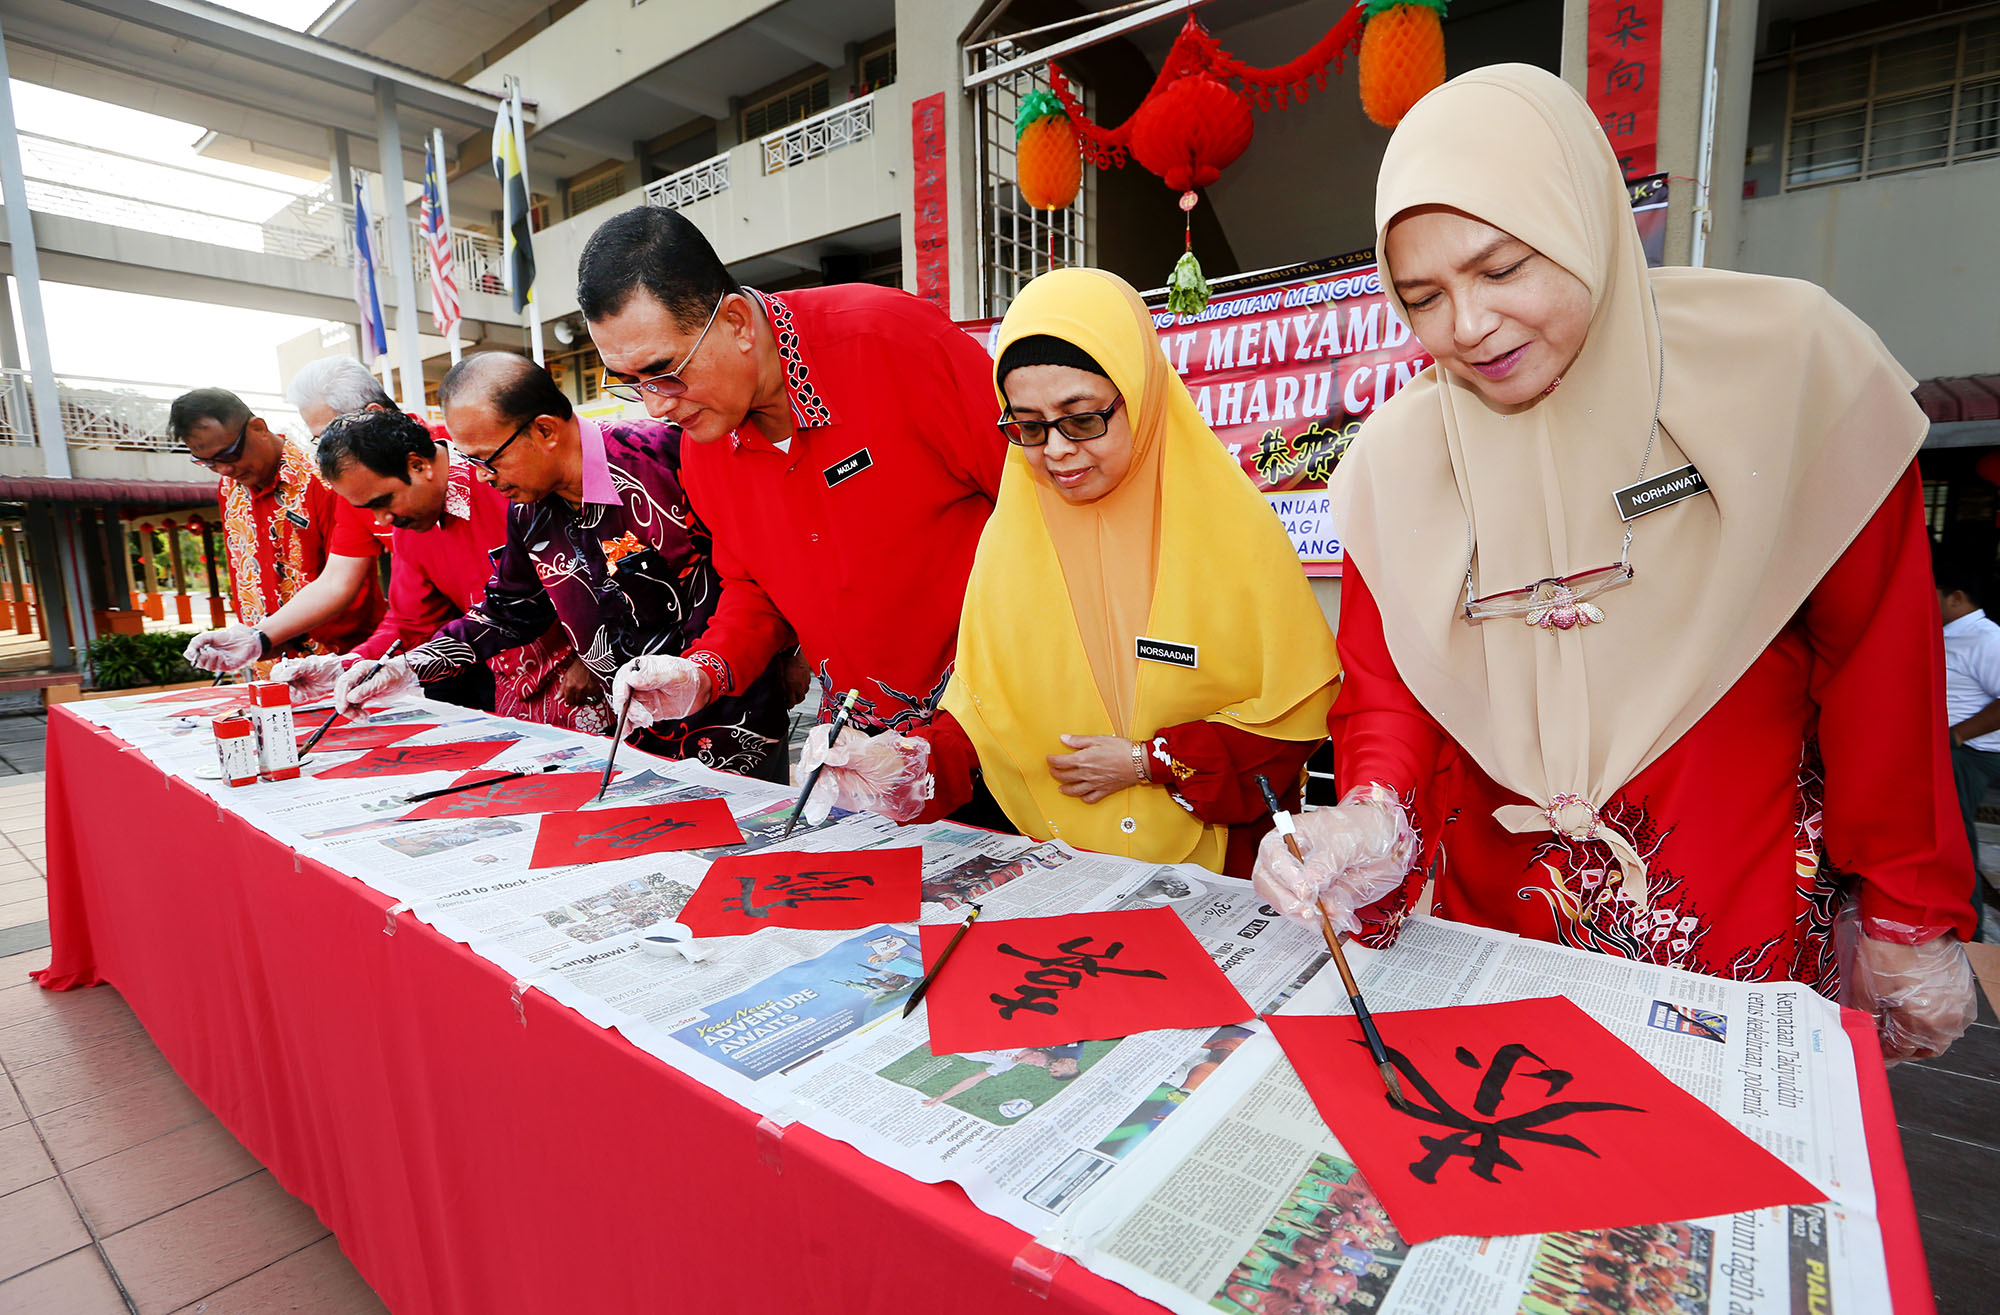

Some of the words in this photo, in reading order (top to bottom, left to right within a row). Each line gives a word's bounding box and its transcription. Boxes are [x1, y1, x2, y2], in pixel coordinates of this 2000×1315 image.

[1239, 262, 1325, 286] RAMBUTAN,
[1329, 249, 1373, 268] 31250
[1286, 274, 1386, 307] MENGUC
[1204, 302, 1411, 372] MENYAMB
[1196, 371, 1333, 427] AHARU
[1631, 473, 1702, 506] NORHAWATI
[1140, 646, 1193, 662] NORSAADAH
[491, 878, 528, 892] stock
[1241, 920, 1268, 938] TMC
[550, 947, 627, 970] Langkawi
[1220, 947, 1255, 973] Stubbor
[696, 1017, 733, 1038] Your
[736, 1000, 775, 1020] News
[704, 988, 820, 1047] ADVENTURE
[1748, 992, 1764, 1017] cetus
[1771, 992, 1797, 1048] Kenyataan
[719, 1013, 800, 1055] AWAITS
[1738, 1067, 1770, 1118] polemik
[926, 1115, 967, 1145] experience
[946, 1120, 980, 1142] Ronaldo
[1720, 1252, 1765, 1300] tagih
